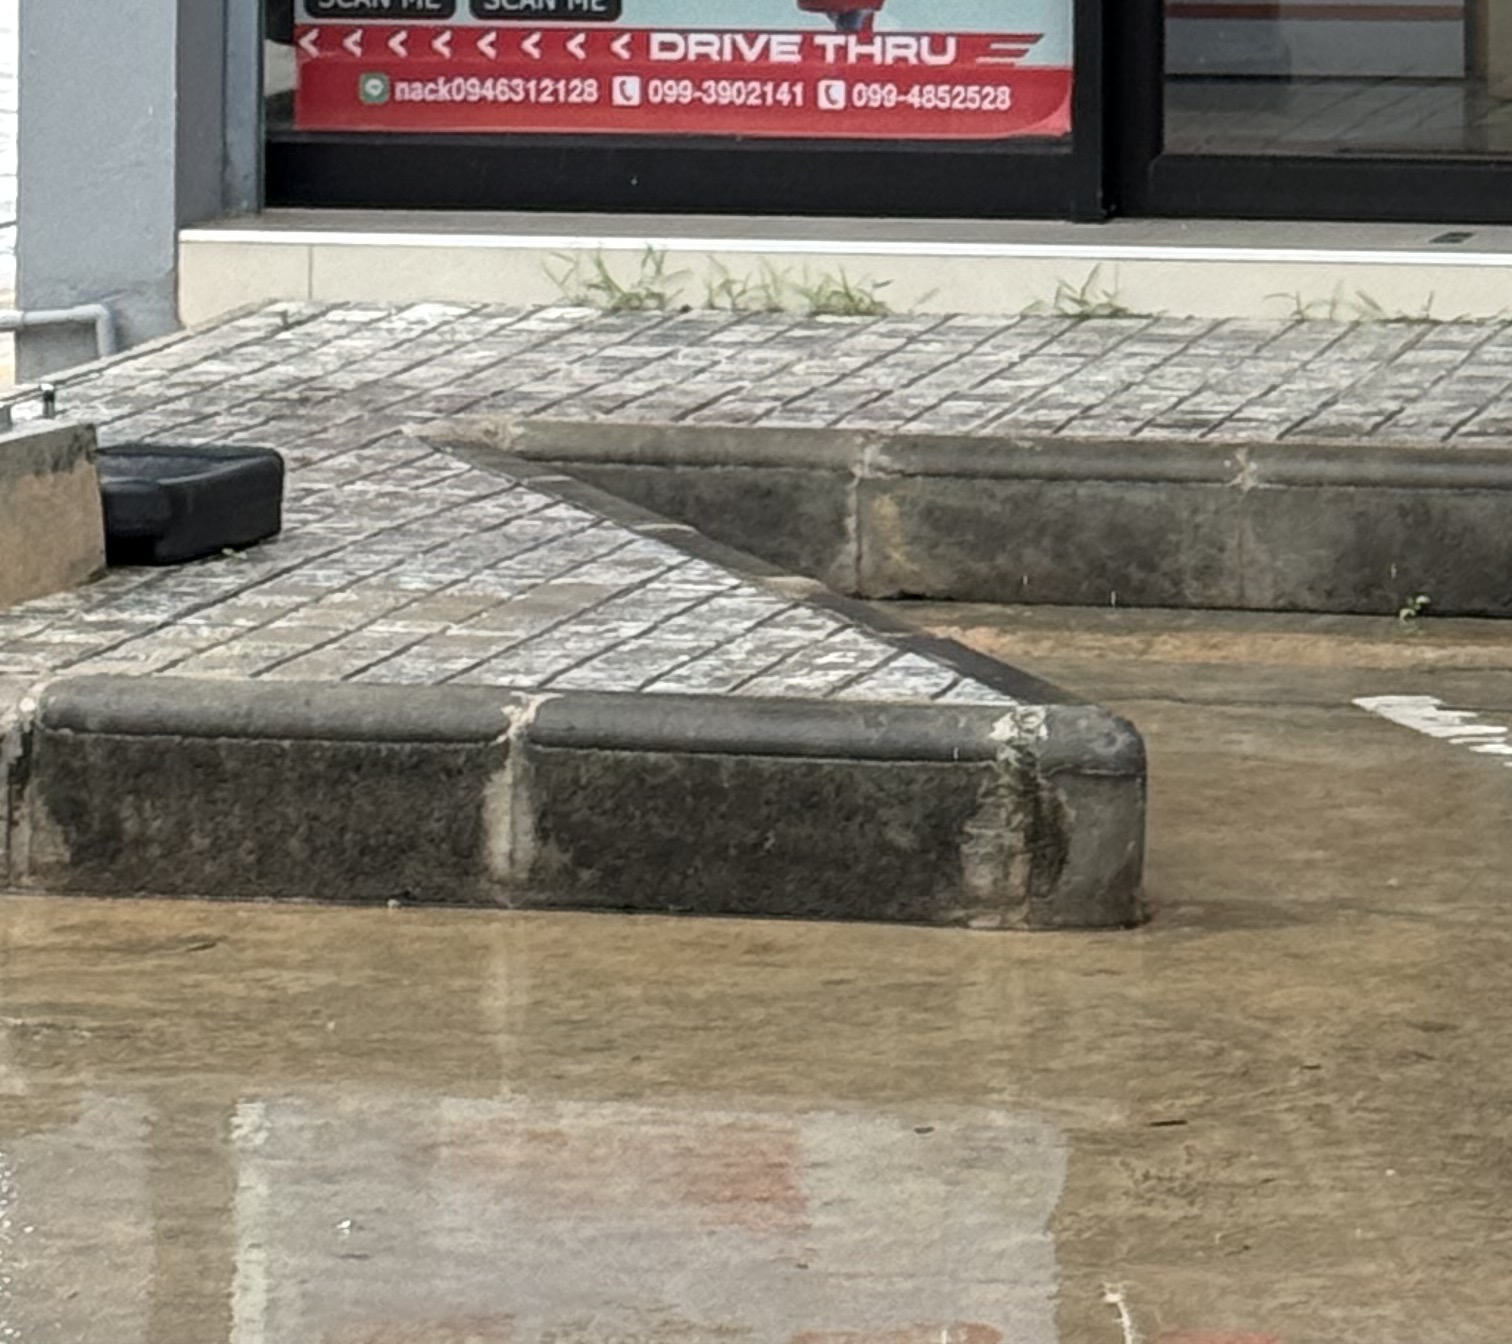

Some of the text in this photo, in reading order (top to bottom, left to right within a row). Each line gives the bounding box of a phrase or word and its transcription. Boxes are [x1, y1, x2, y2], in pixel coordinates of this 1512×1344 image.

[649, 33, 958, 65] DRIVE THRU
[394, 77, 1012, 110] nack0946312128 099-3902141 099-4852528
